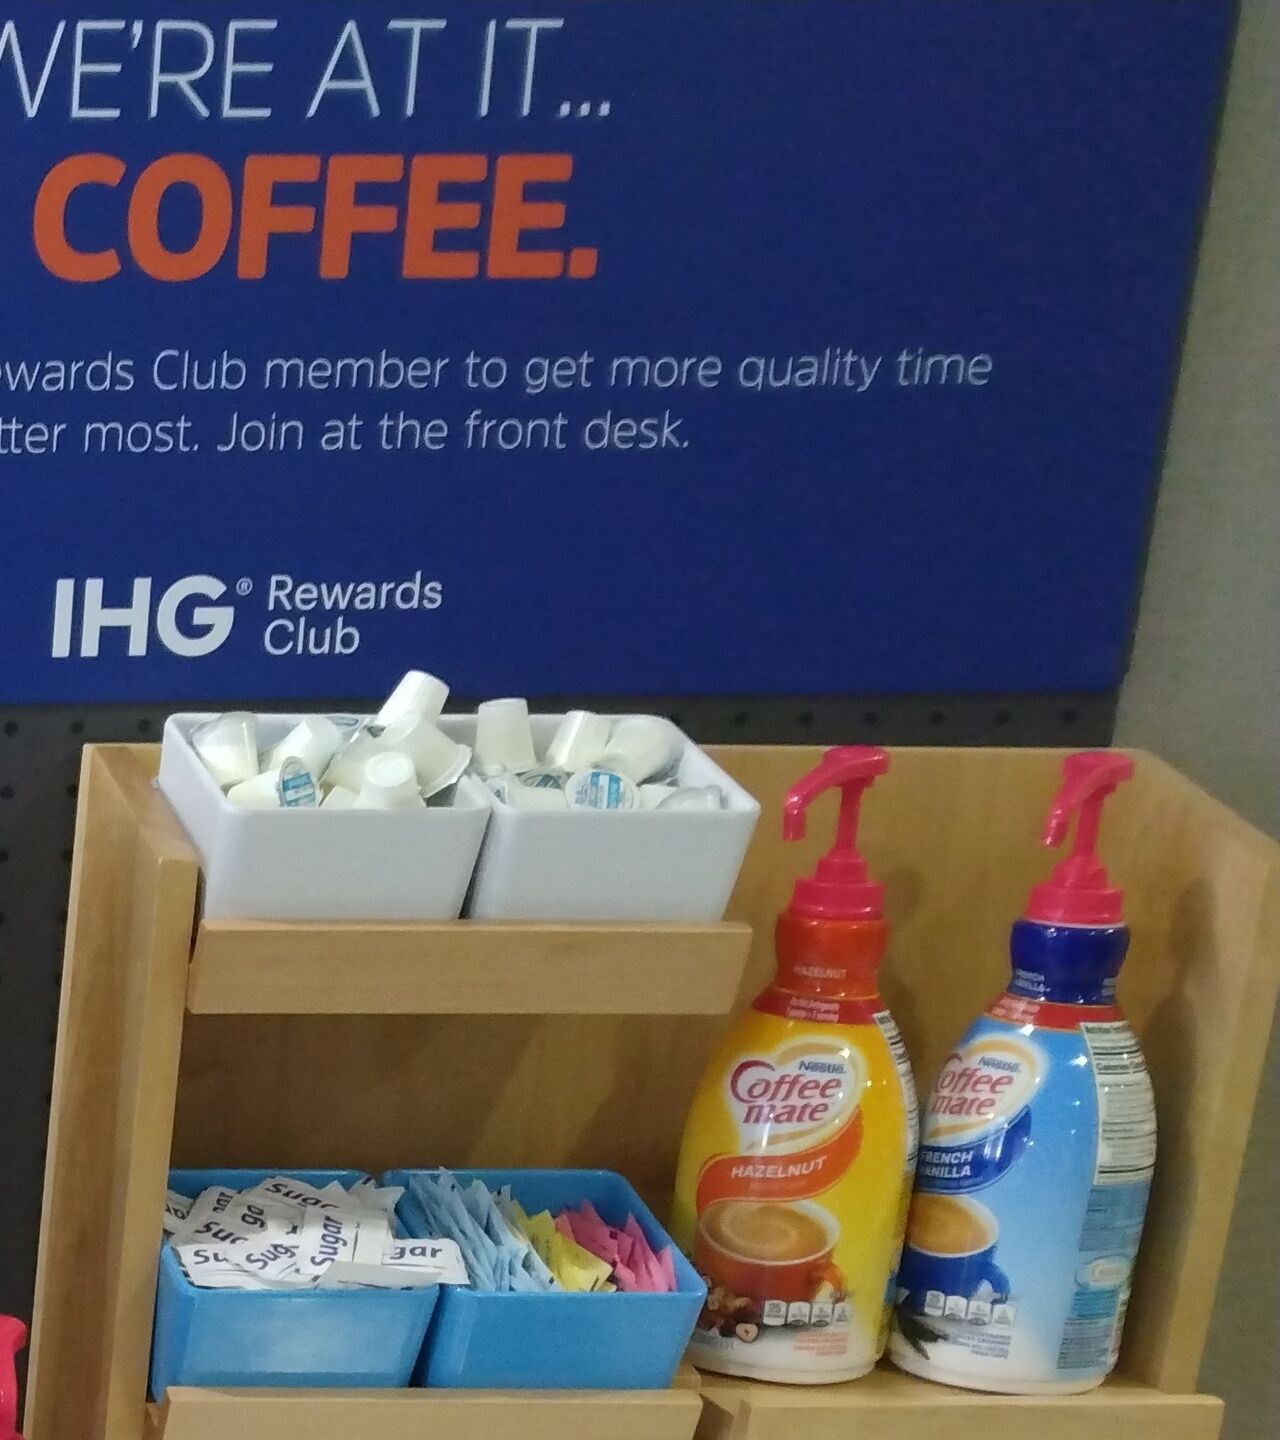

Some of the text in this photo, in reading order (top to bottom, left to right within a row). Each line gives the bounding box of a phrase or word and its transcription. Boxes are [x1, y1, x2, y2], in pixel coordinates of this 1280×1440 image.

[306, 18, 447, 118] AT
[479, 18, 611, 117] IT...
[33, 154, 598, 282] COFFEE.
[153, 349, 247, 391] Club
[264, 348, 450, 390] member
[465, 350, 508, 389] to
[525, 350, 594, 394] get
[610, 356, 722, 388] more
[739, 347, 882, 392] quality
[896, 348, 993, 387] time
[84, 414, 199, 453] most.
[216, 411, 304, 452] Join
[320, 413, 364, 451] at
[378, 410, 448, 450] the
[464, 409, 569, 450] front
[584, 409, 689, 450] desk.
[267, 570, 443, 611] Rewards
[263, 615, 361, 656] Club
[730, 1059, 843, 1104] Coffee
[743, 1101, 830, 1124] mate
[730, 1155, 828, 1179] HAZELNUT
[309, 1214, 349, 1268] Sugar
